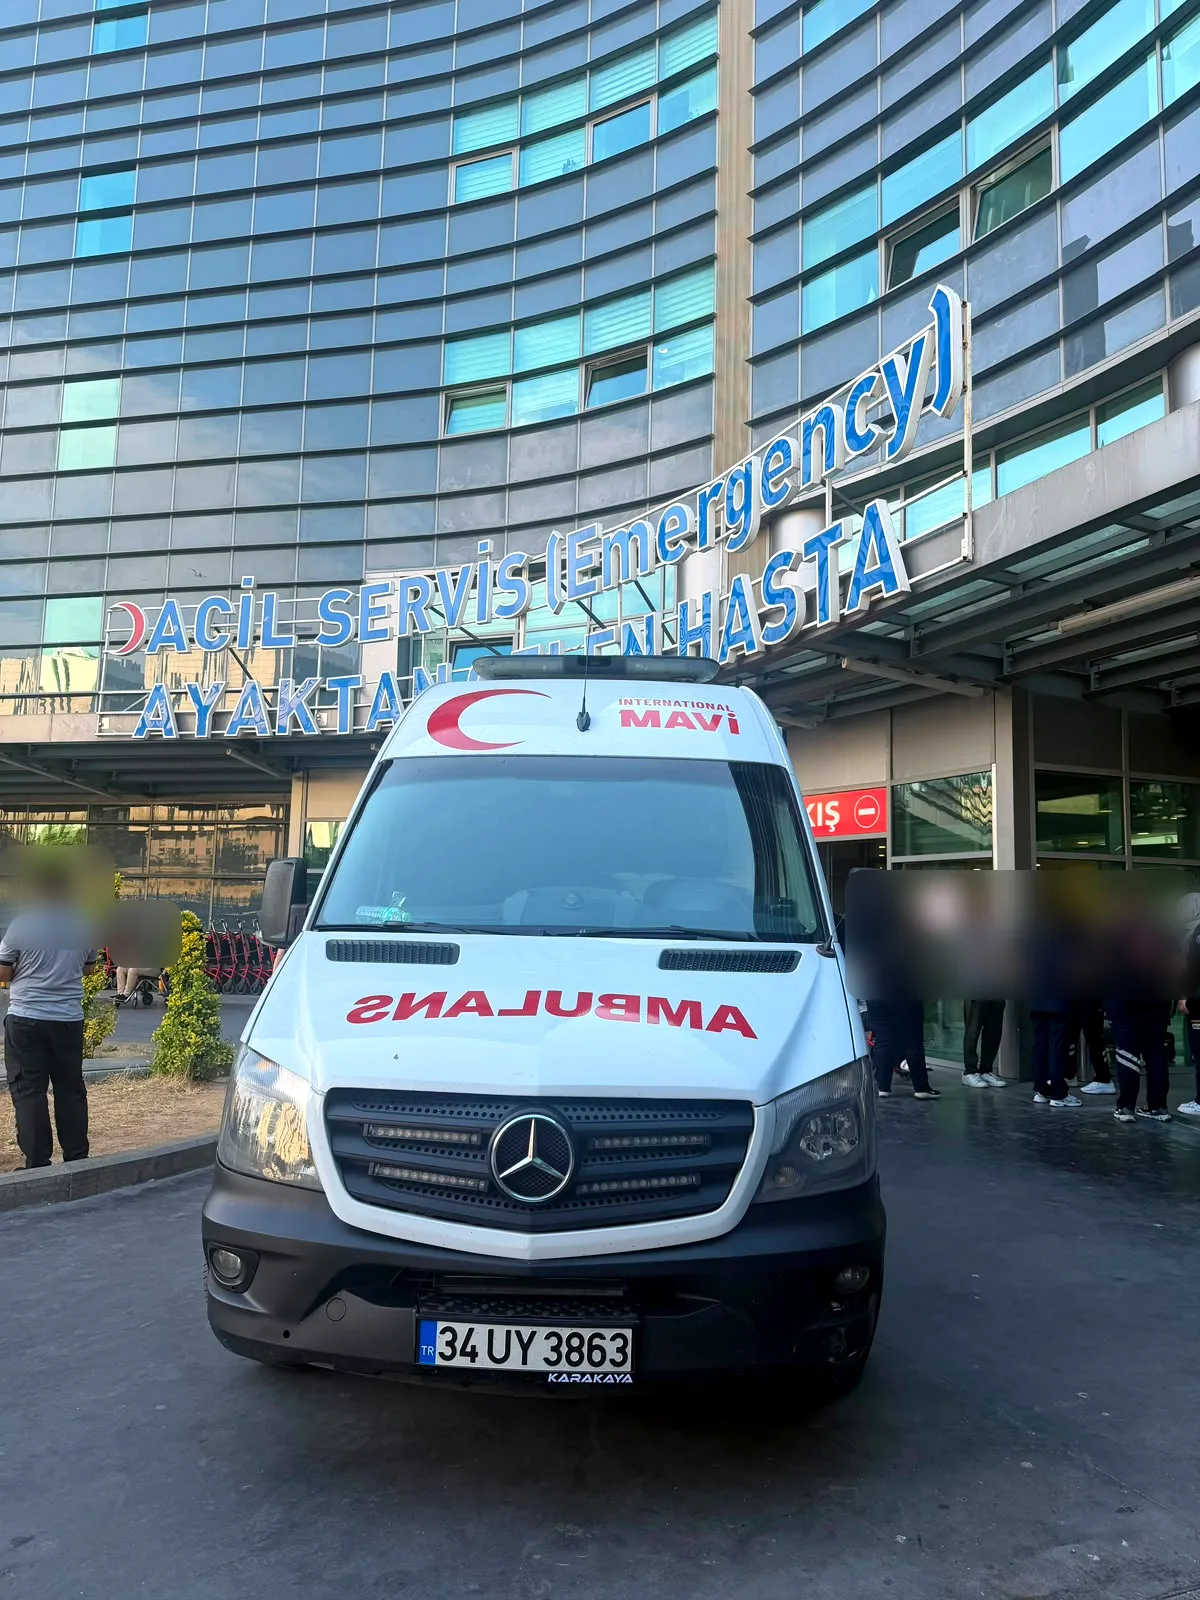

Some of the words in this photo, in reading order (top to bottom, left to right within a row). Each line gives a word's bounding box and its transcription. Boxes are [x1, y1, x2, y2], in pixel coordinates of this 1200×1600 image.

[144, 575, 298, 655] ACİL
[314, 539, 532, 648] SERVİS
[546, 283, 962, 615] (Emergency)
[679, 498, 911, 665] HASTA
[618, 698, 735, 712] INTERNATIONAL
[421, 1345, 434, 1356] TR
[438, 1326, 479, 1363] 34
[487, 1328, 537, 1365] UY
[543, 1331, 629, 1367] 3863
[547, 1373, 634, 1383] KARAKAYA
